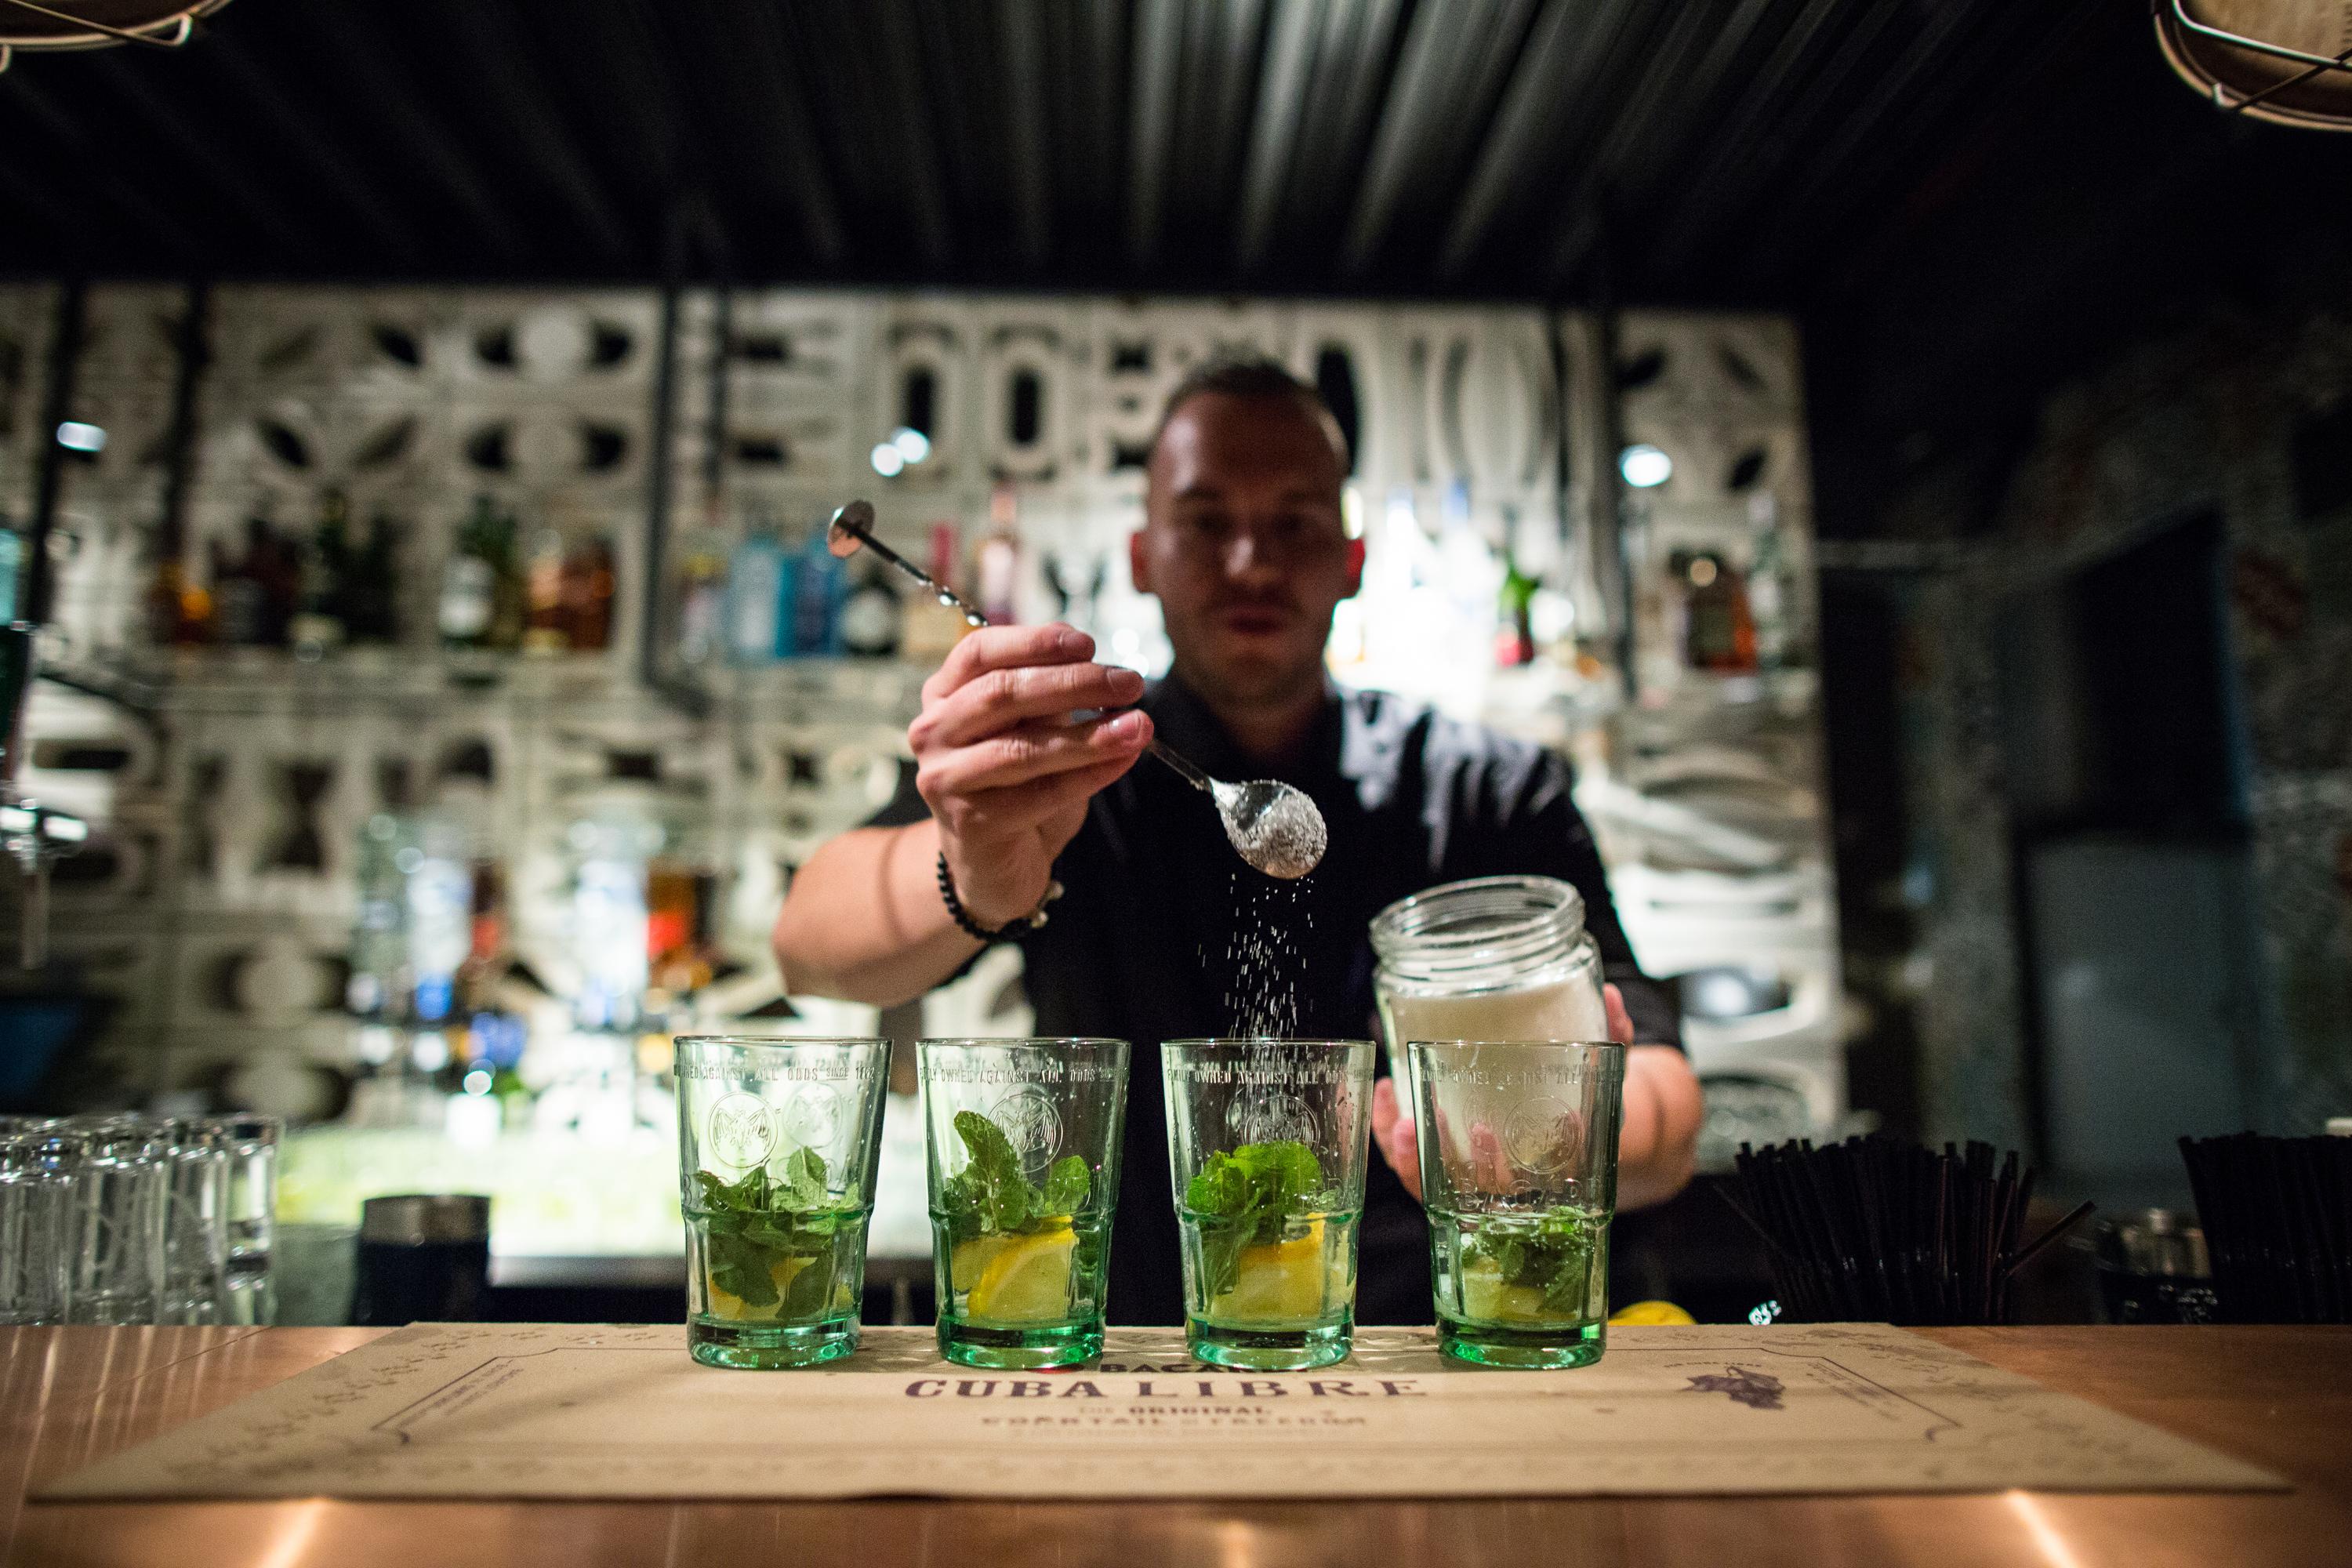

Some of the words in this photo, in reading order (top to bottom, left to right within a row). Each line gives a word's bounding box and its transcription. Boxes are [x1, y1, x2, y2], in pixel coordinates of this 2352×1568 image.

[703, 1066, 745, 1080] AGAINST
[754, 1067, 779, 1080] ALL
[787, 1066, 818, 1080] ODDS
[941, 1069, 974, 1083] OWNED
[980, 1069, 1030, 1083] AGAINST
[1069, 1069, 1095, 1083] ODDS
[1194, 1070, 1232, 1083] OWNED
[1237, 1070, 1288, 1084] AGAINST
[1296, 1070, 1319, 1084] ALL
[905, 1379, 1108, 1398] CUBA
[1137, 1379, 1428, 1398] LIBRE
